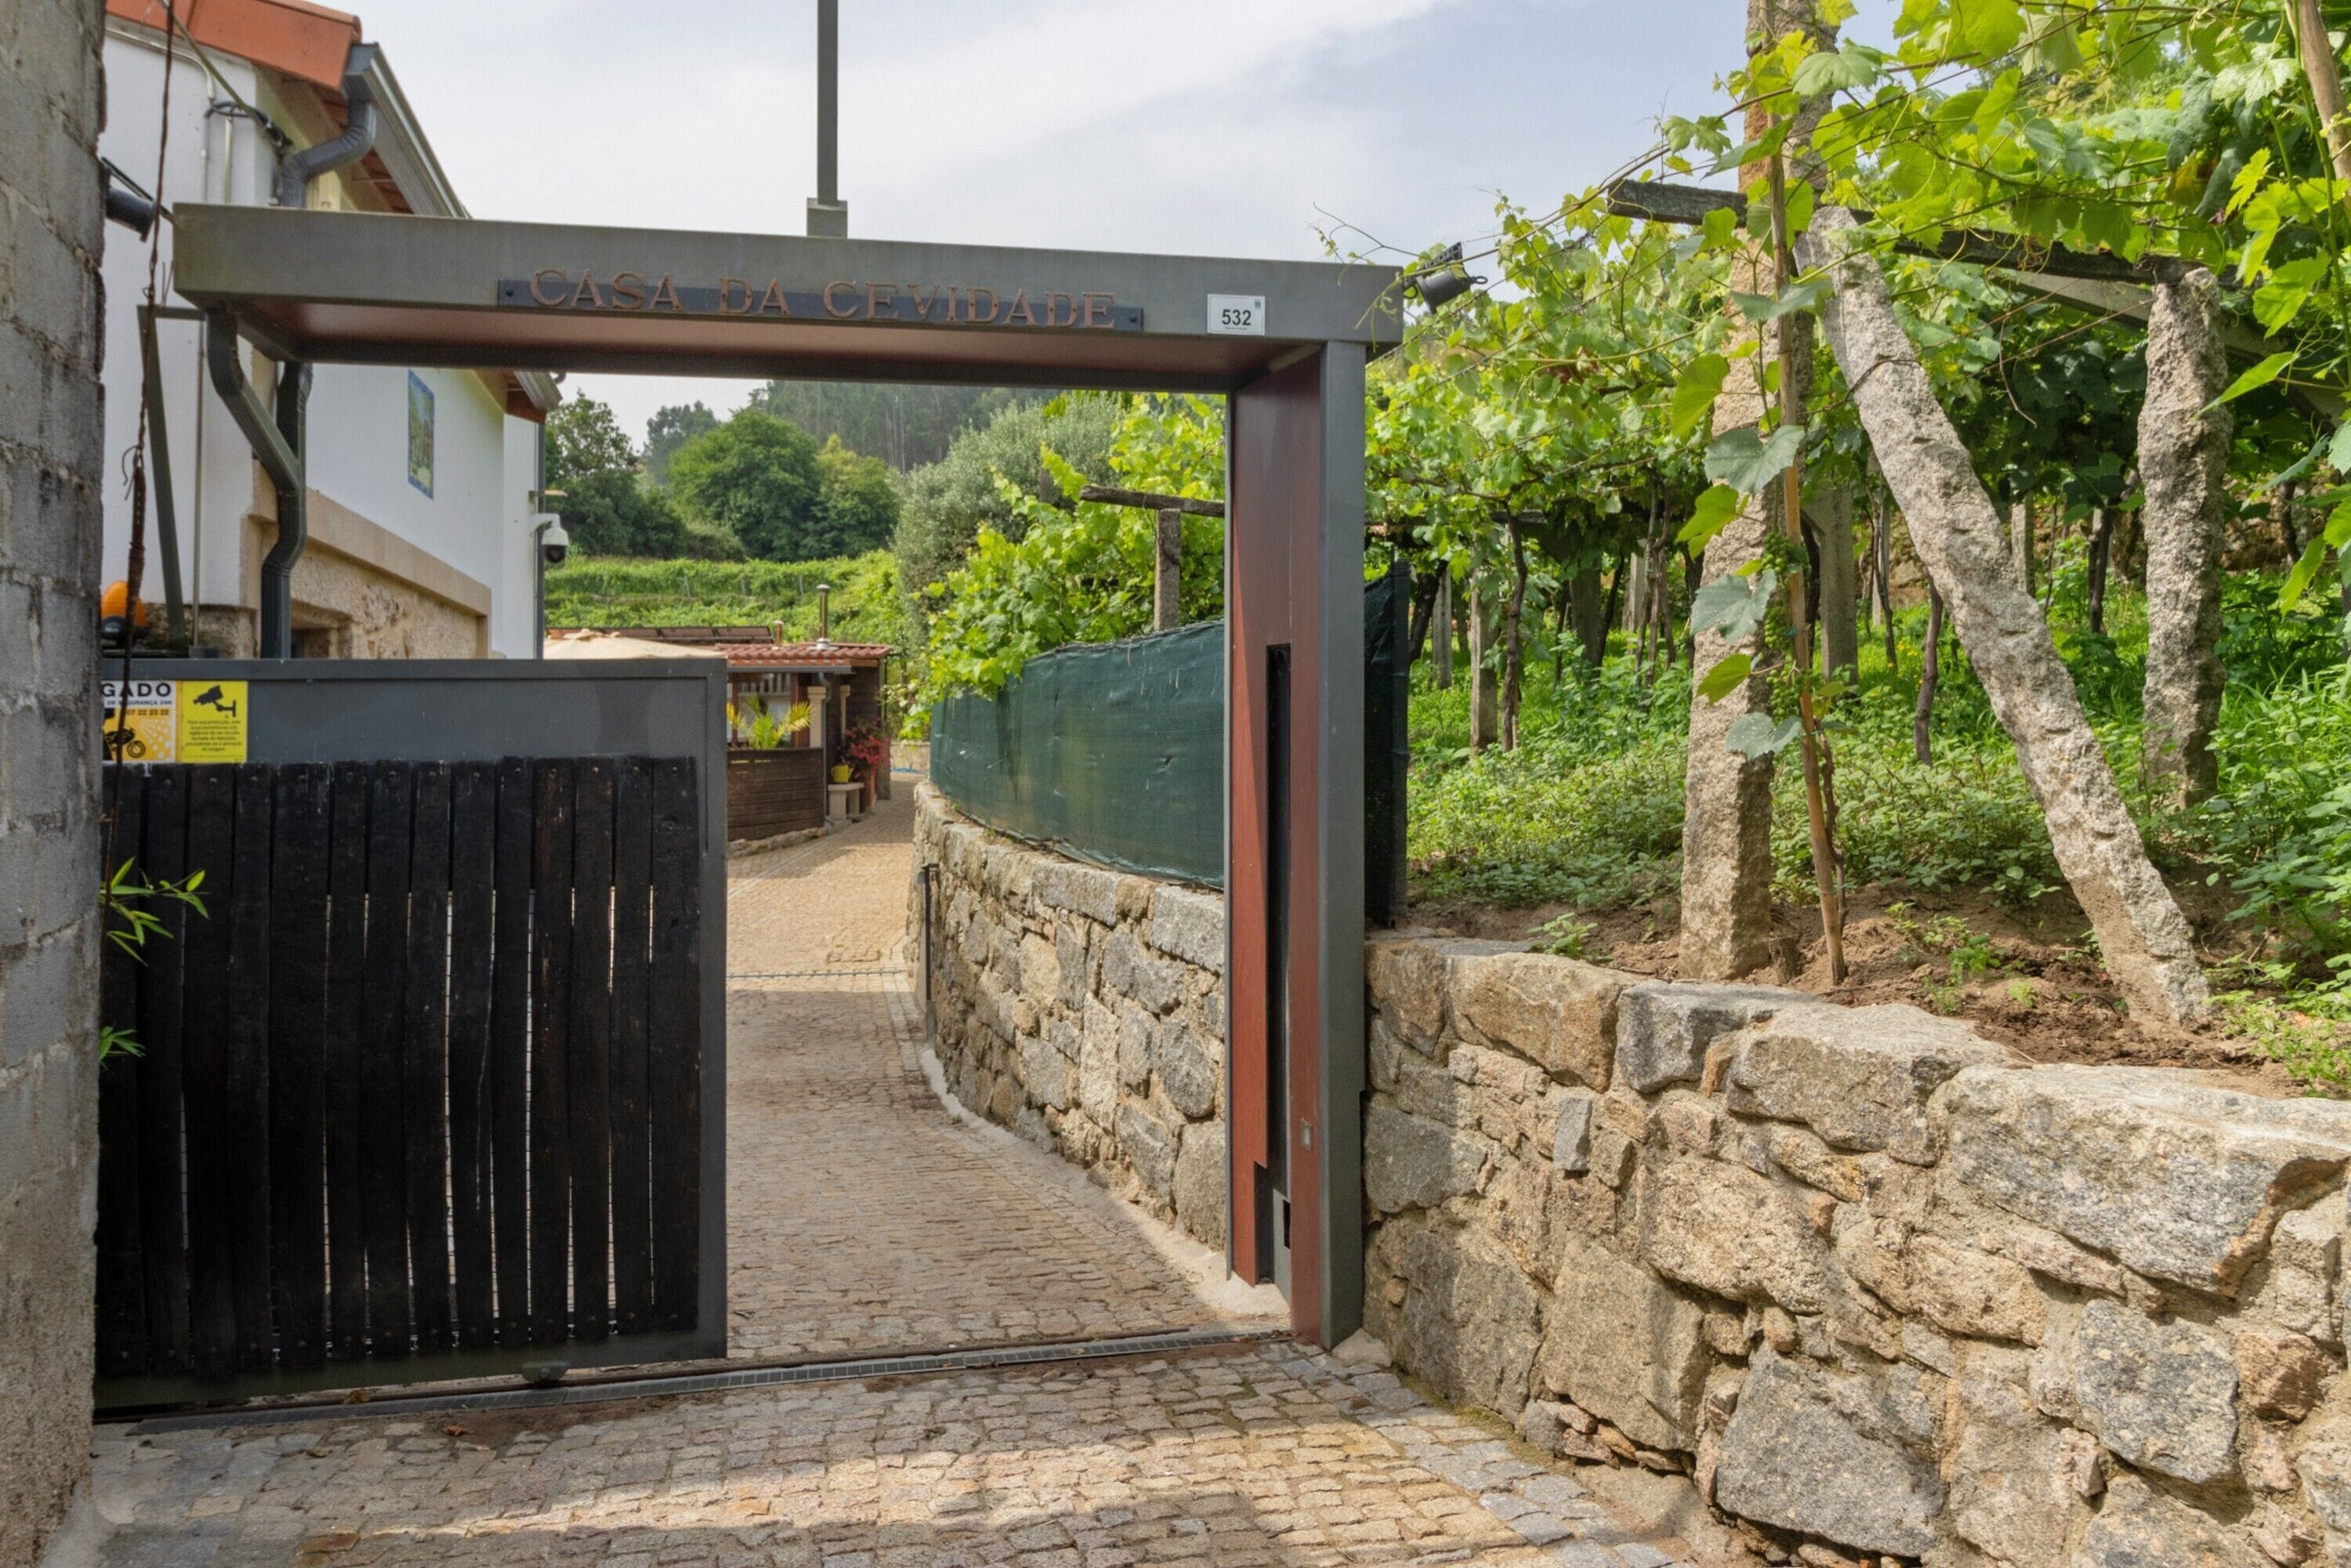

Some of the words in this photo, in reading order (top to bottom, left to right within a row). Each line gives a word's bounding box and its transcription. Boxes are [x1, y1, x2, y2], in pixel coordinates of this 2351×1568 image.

[530, 267, 683, 312] CASA
[719, 276, 789, 316] DA
[823, 279, 1116, 329] CEVIDADE
[1222, 309, 1252, 326] 532
